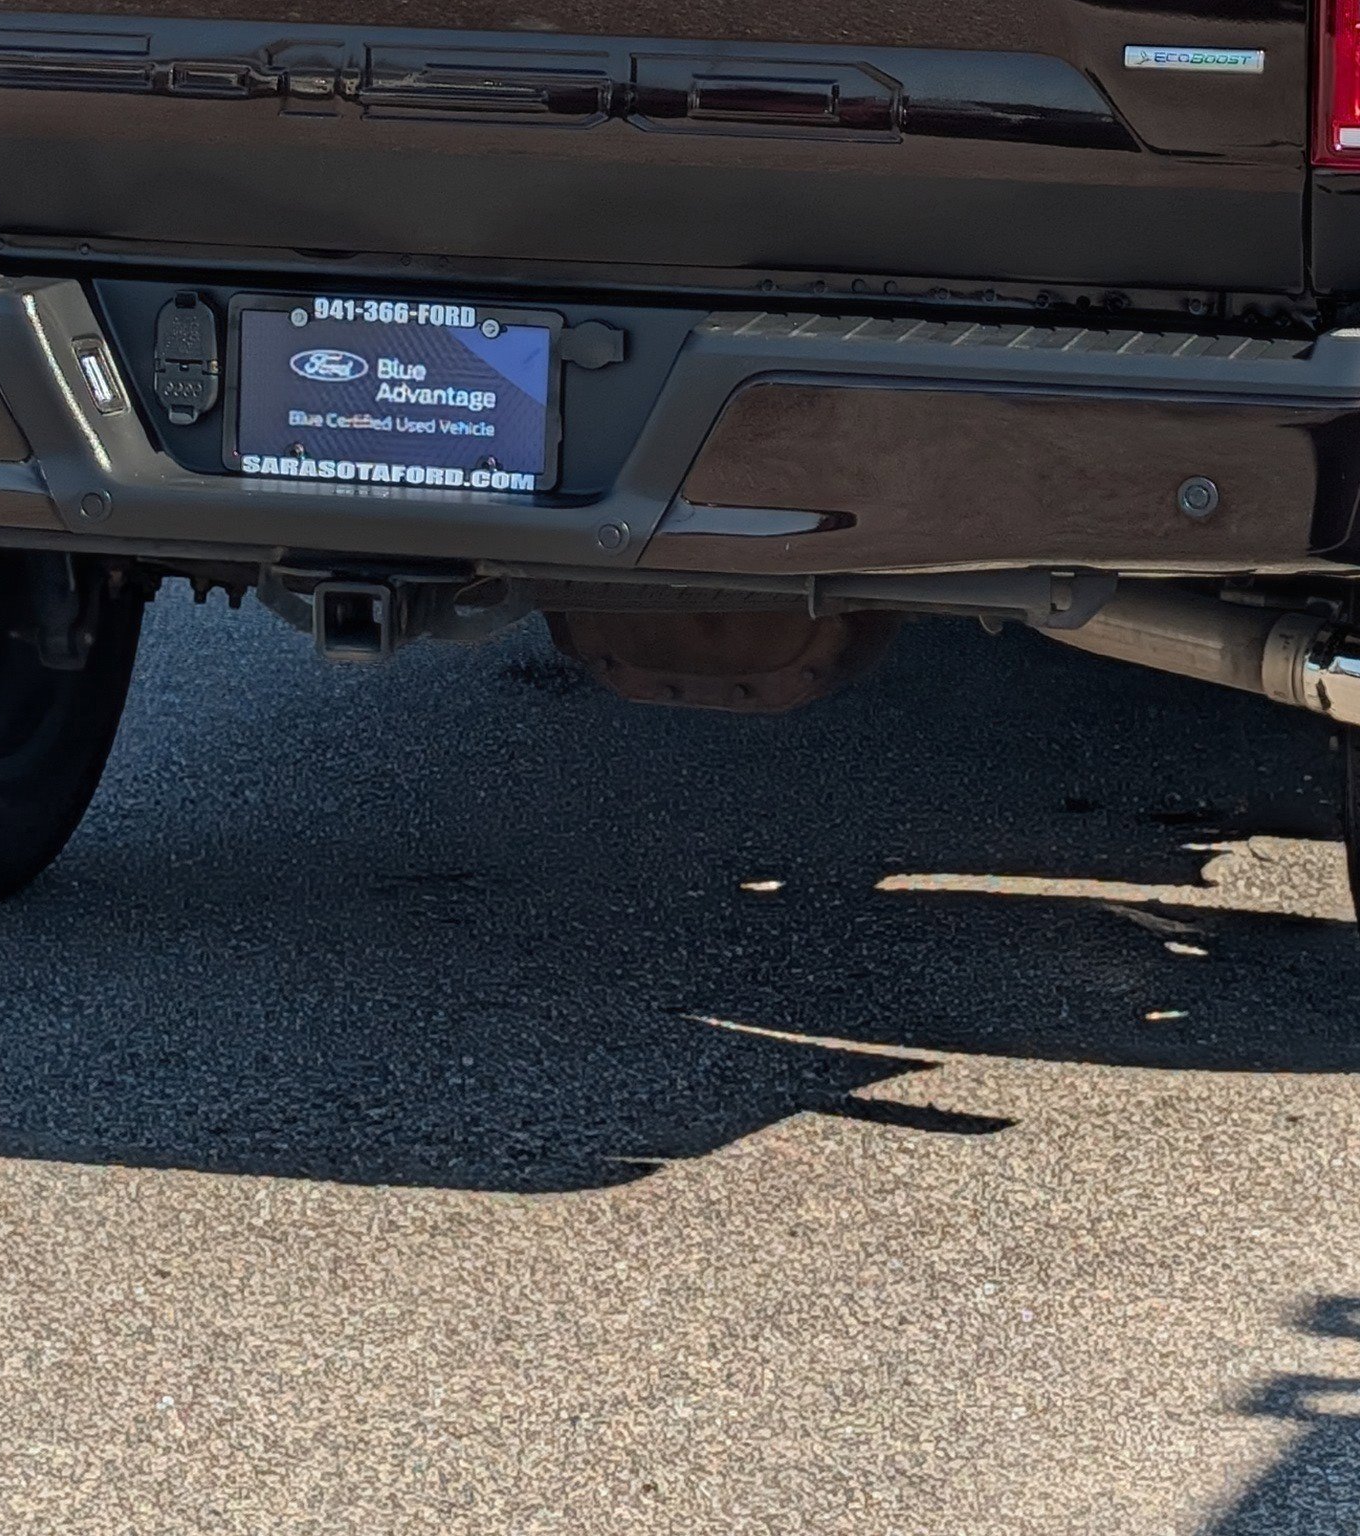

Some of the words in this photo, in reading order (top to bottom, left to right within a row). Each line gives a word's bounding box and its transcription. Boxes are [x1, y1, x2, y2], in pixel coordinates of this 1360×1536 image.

[314, 297, 476, 327] 941-366-FORD
[304, 353, 354, 377] Ford
[377, 358, 426, 381] Blue
[375, 382, 496, 410] Advantage
[288, 410, 323, 427] Blue
[325, 412, 392, 431] Certified
[396, 417, 436, 434] Used
[439, 419, 495, 437] Vehicle
[241, 454, 535, 490] SARASOTAFORD.COM
